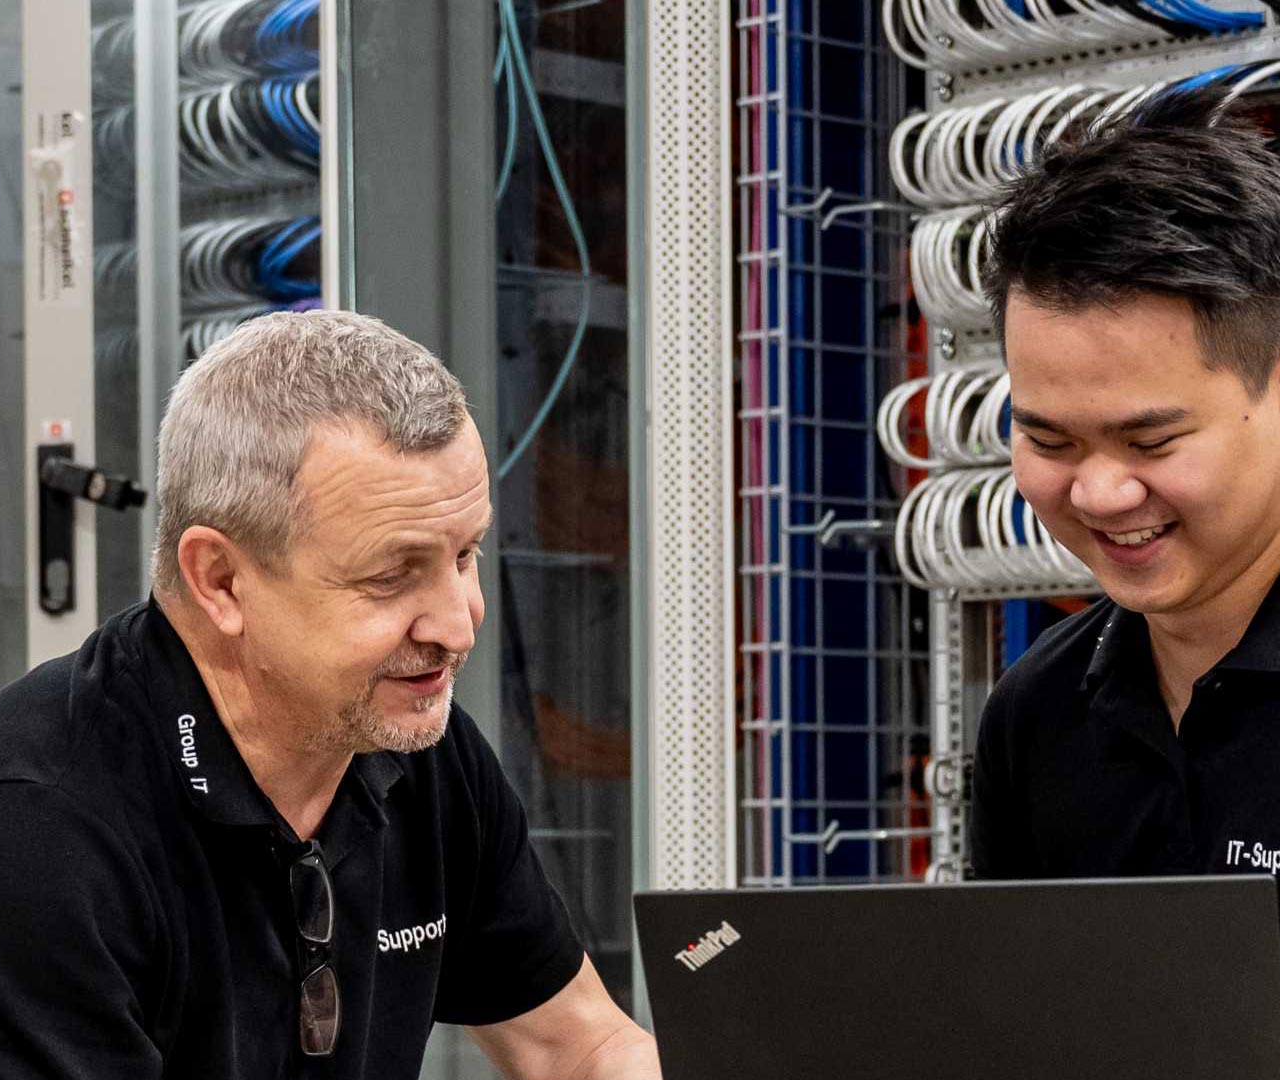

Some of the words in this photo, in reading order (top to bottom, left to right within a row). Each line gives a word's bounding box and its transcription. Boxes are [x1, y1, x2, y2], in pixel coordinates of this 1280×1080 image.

[177, 714, 199, 768] Group
[189, 777, 209, 794] IT
[673, 920, 742, 972] ThinkPad
